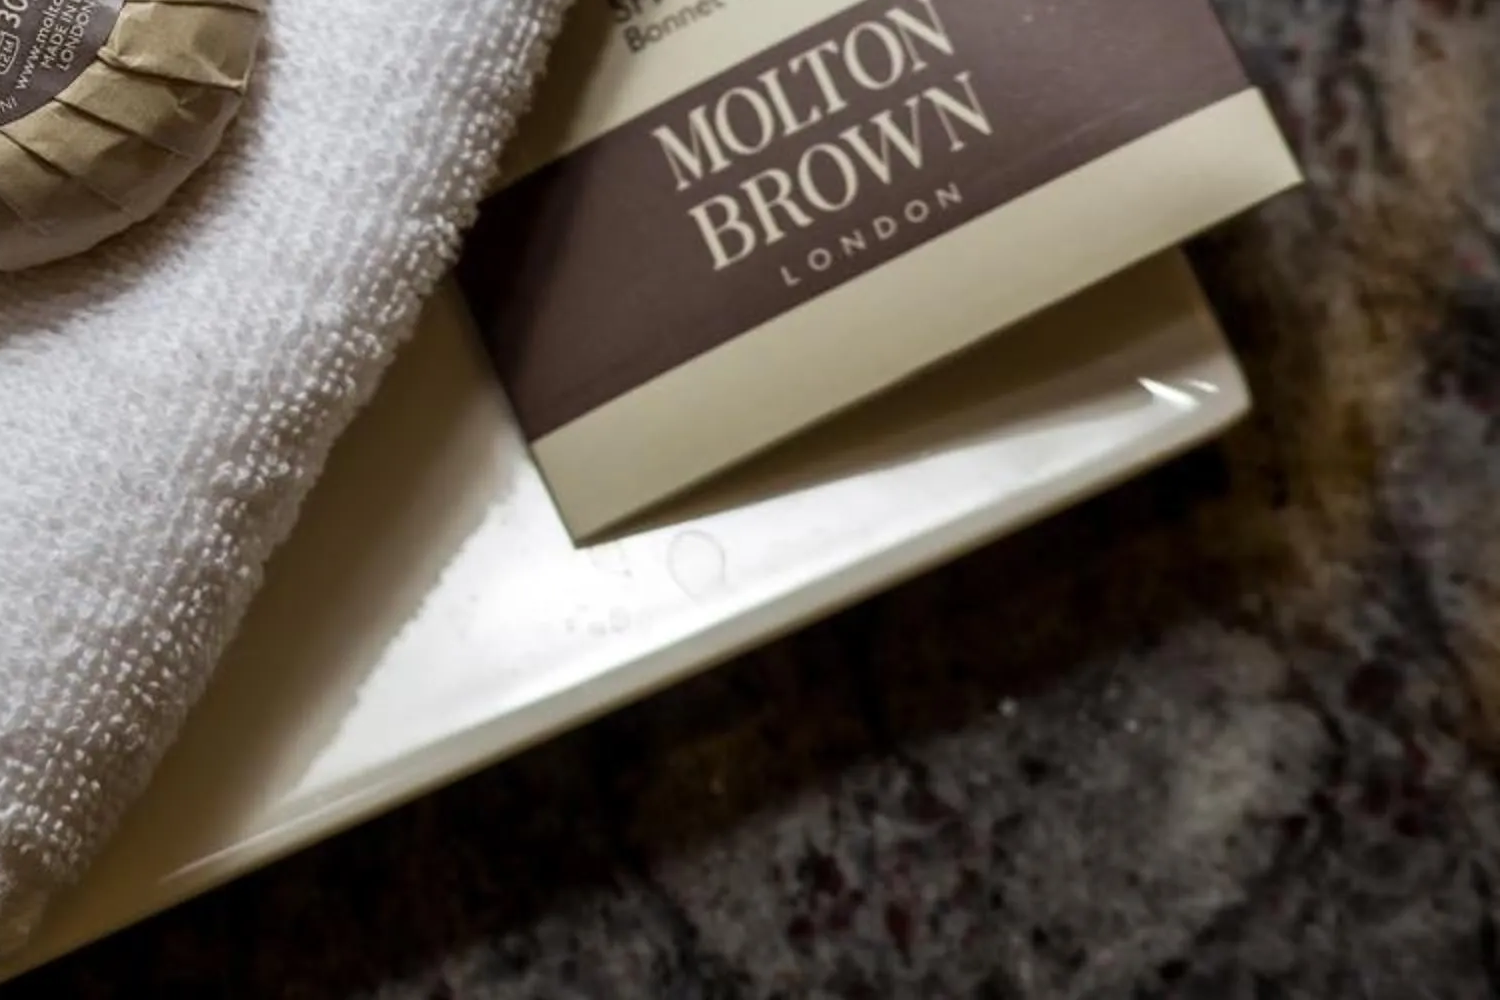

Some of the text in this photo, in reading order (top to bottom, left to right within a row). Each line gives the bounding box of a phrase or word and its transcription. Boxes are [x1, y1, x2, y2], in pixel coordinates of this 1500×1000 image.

[40, 24, 69, 69] MADE
[60, 3, 77, 24] IN
[58, 0, 96, 71] LONDON
[688, 71, 993, 271] BROWN
[781, 182, 962, 286] LONDON
